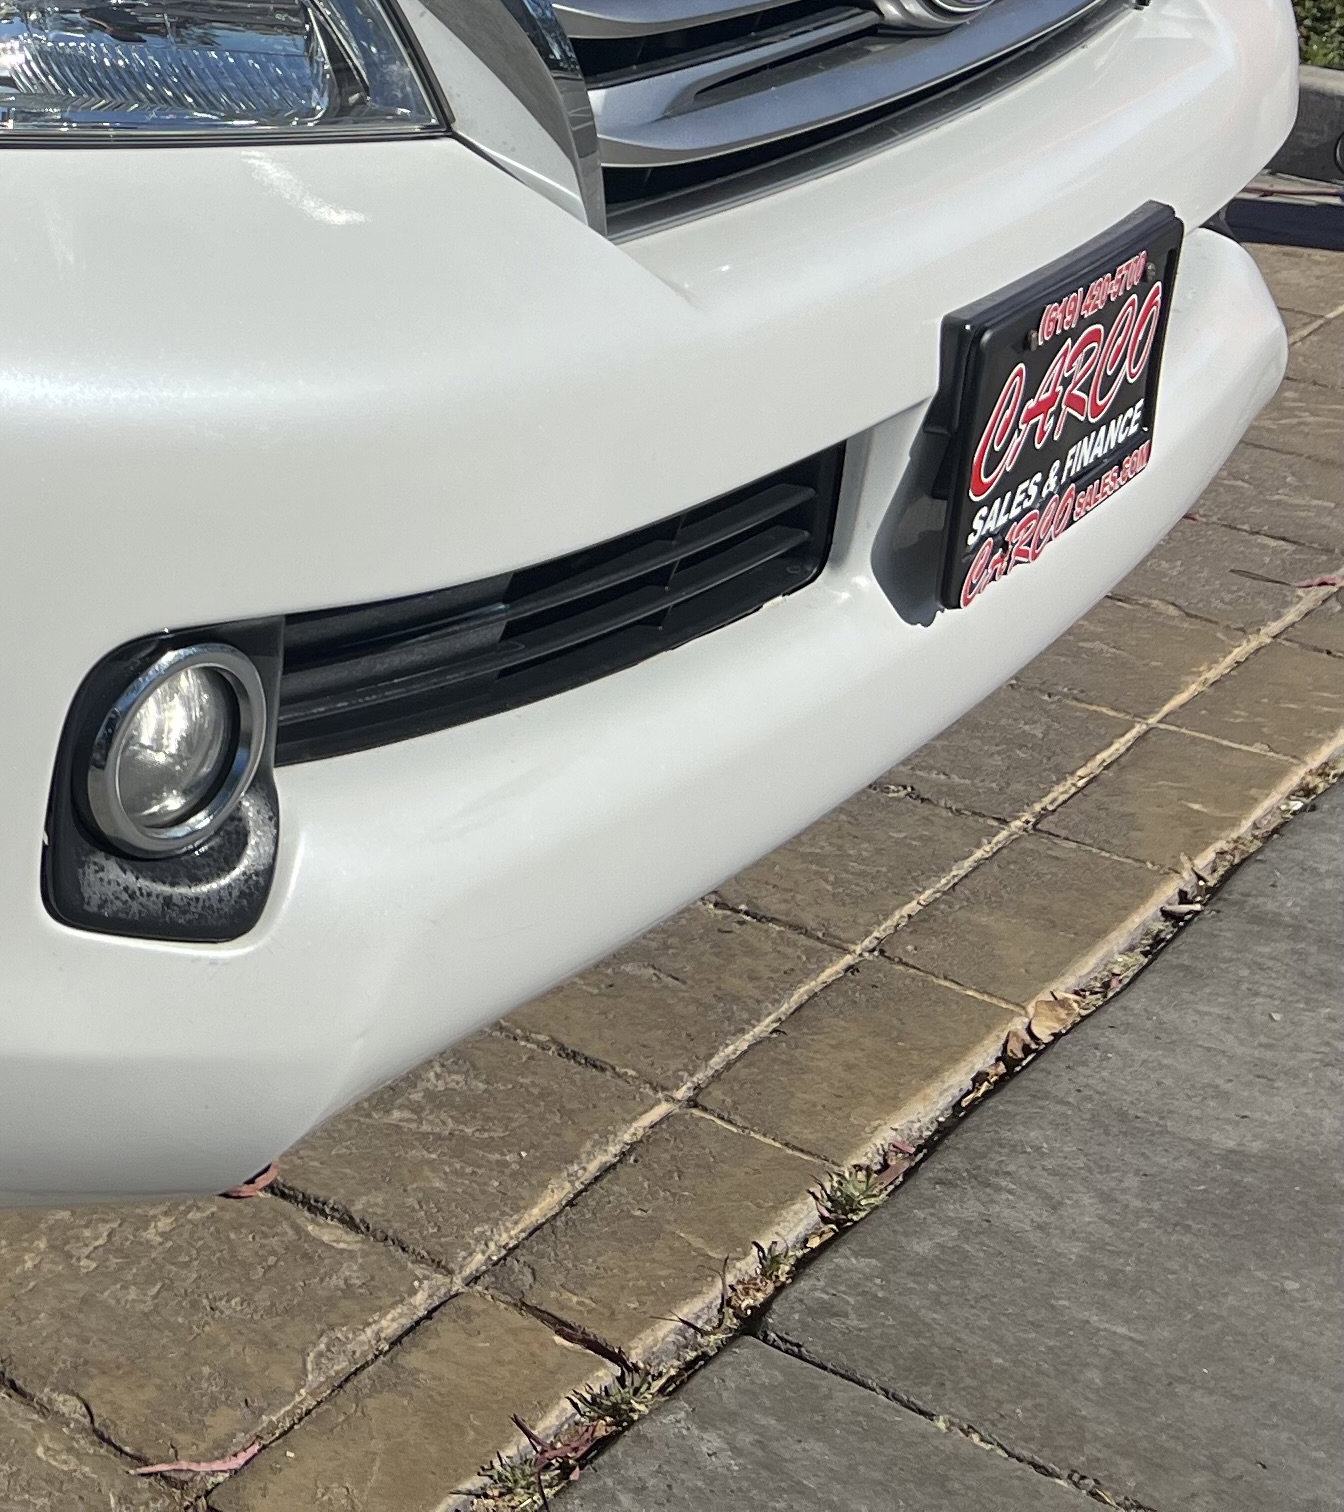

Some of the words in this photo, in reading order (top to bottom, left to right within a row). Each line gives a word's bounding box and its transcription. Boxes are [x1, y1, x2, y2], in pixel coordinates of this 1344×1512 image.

[967, 471, 1043, 546] SALES
[1041, 459, 1061, 499] &
[1061, 397, 1146, 486] FINANCE
